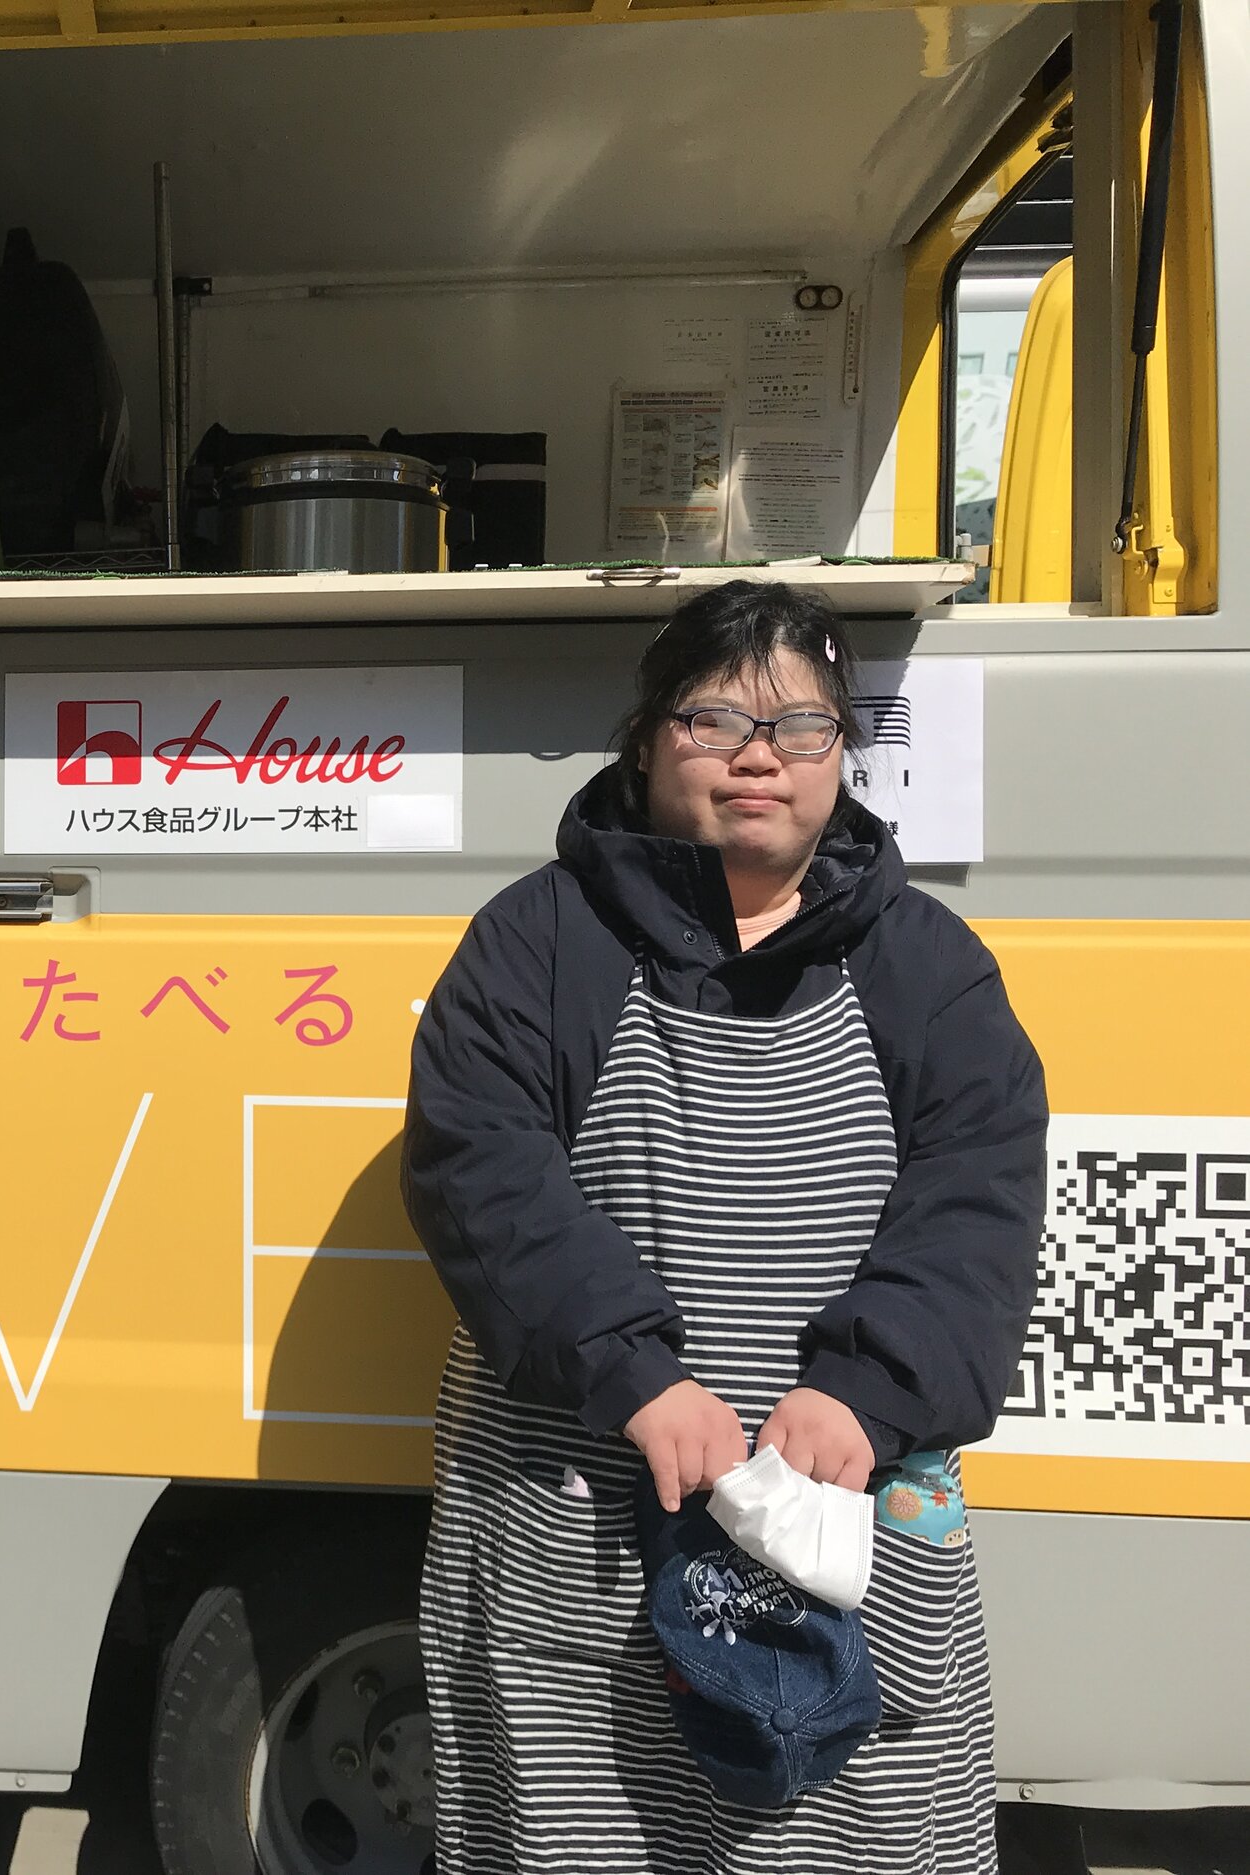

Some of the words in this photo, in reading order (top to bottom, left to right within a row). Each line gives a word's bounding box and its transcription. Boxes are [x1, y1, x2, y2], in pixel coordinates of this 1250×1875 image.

[152, 696, 406, 785] House
[65, 804, 359, 833] ハウス食品グループ本社
[19, 958, 354, 1047] たべる
[743, 1567, 778, 1589] ONE!
[736, 1579, 786, 1609] NUMBER
